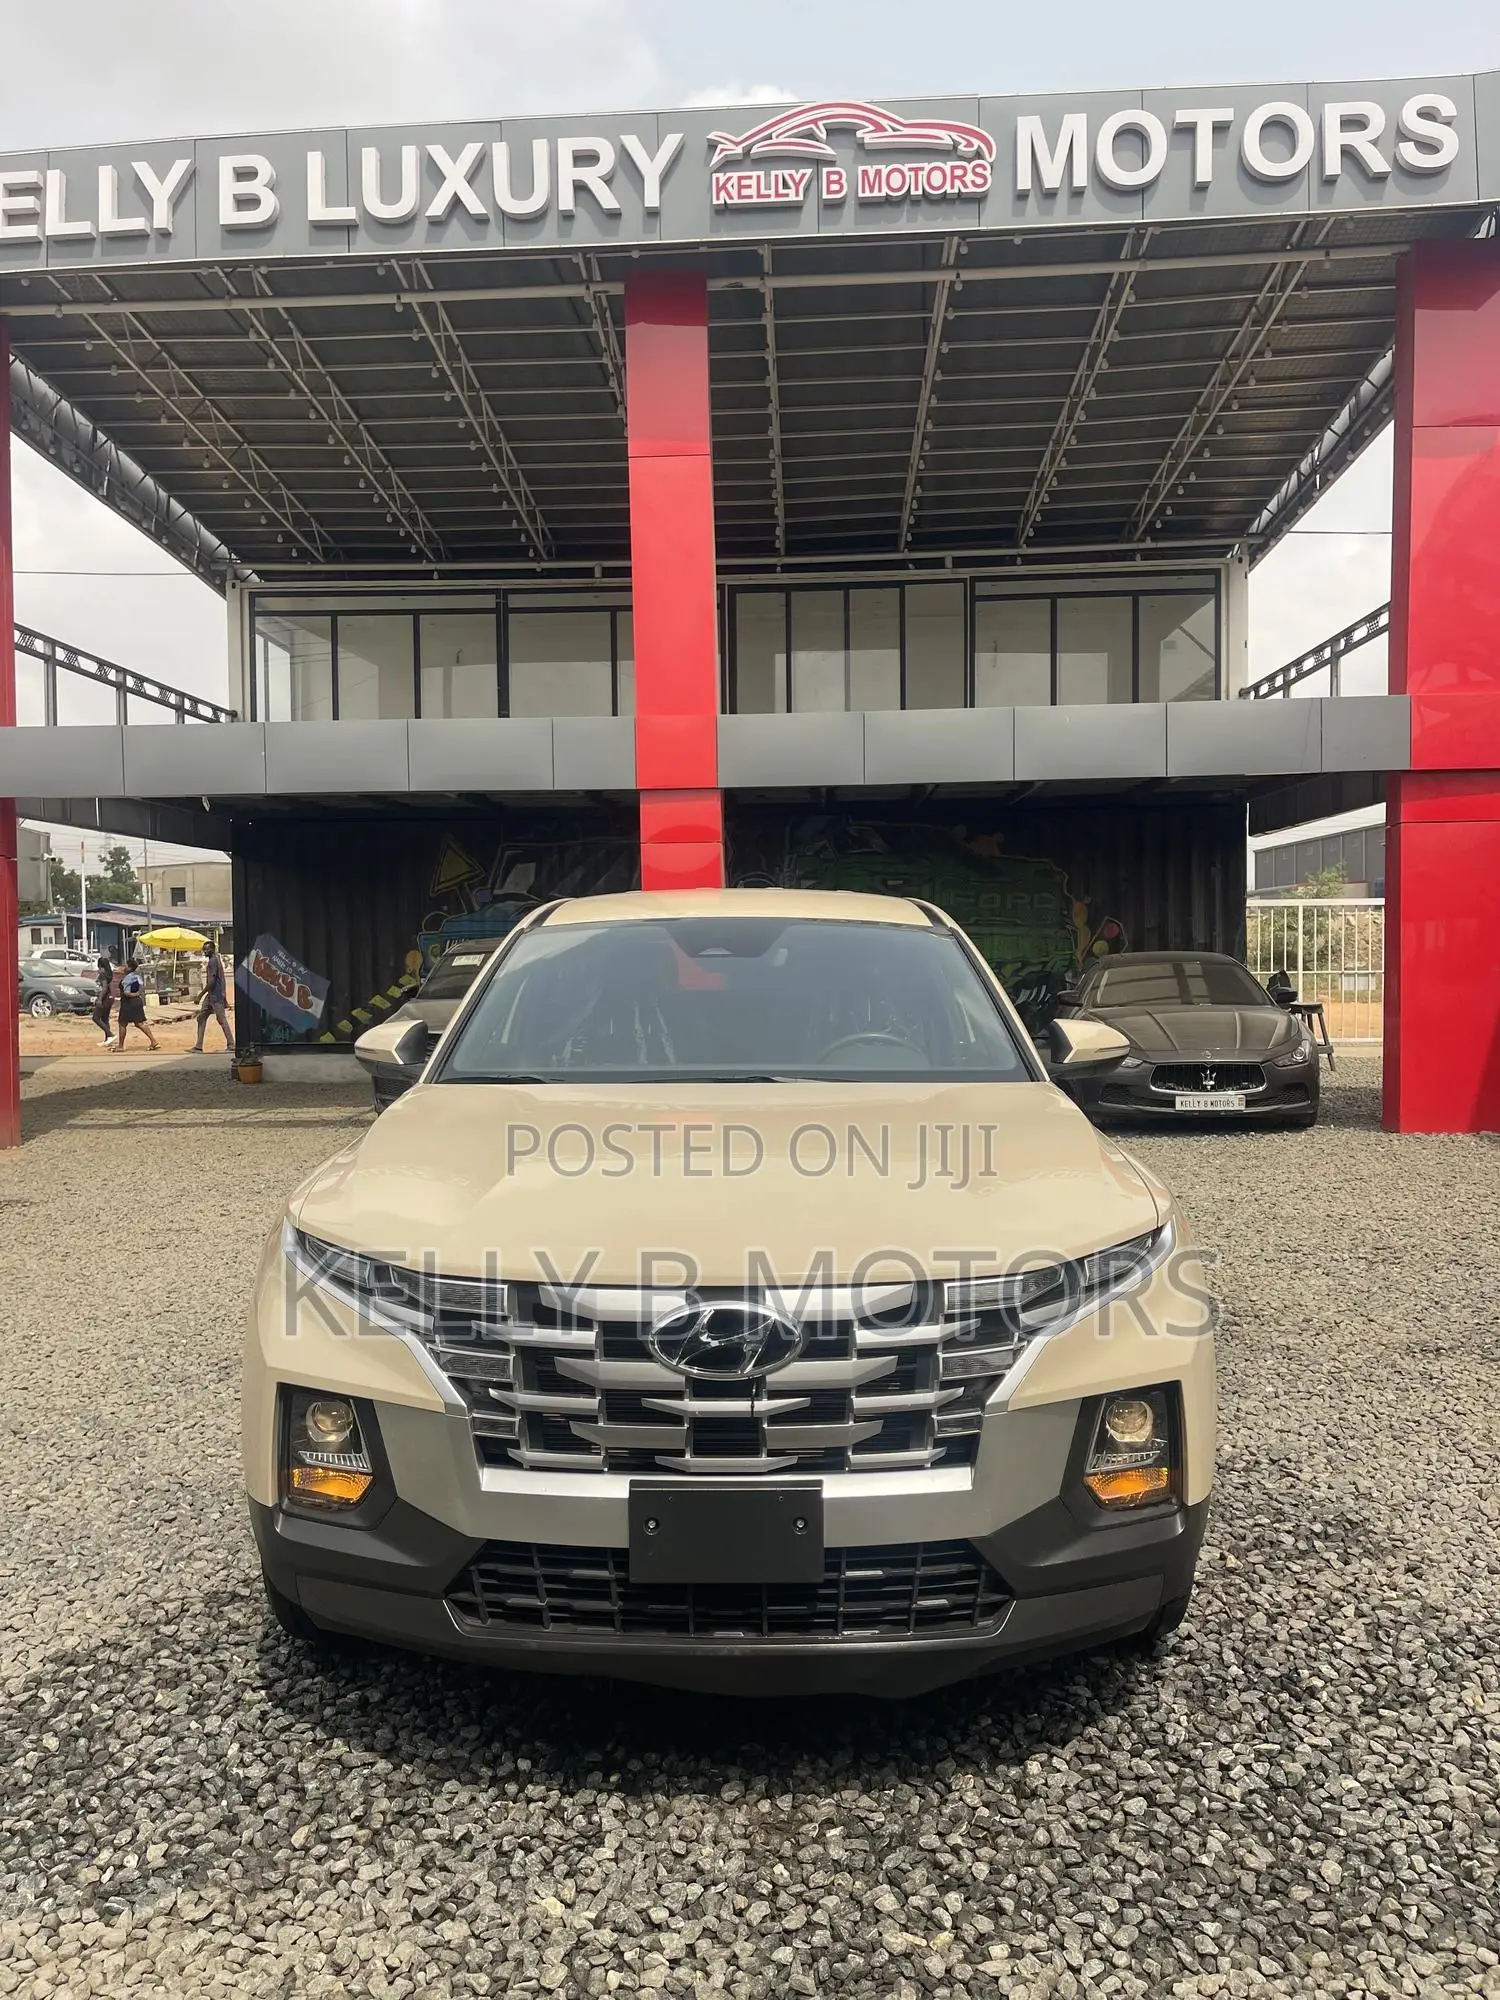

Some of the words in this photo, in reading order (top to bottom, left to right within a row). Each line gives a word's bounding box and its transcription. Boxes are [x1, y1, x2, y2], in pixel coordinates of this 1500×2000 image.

[0, 159, 193, 243] ELLY
[219, 154, 279, 230] B
[307, 133, 685, 226] LUXURY
[1017, 93, 1460, 195] MOTORS
[712, 169, 812, 208] KELLY
[822, 167, 848, 205] B
[858, 160, 992, 202] MOTORS
[1210, 1099, 1235, 1108] MOTORS
